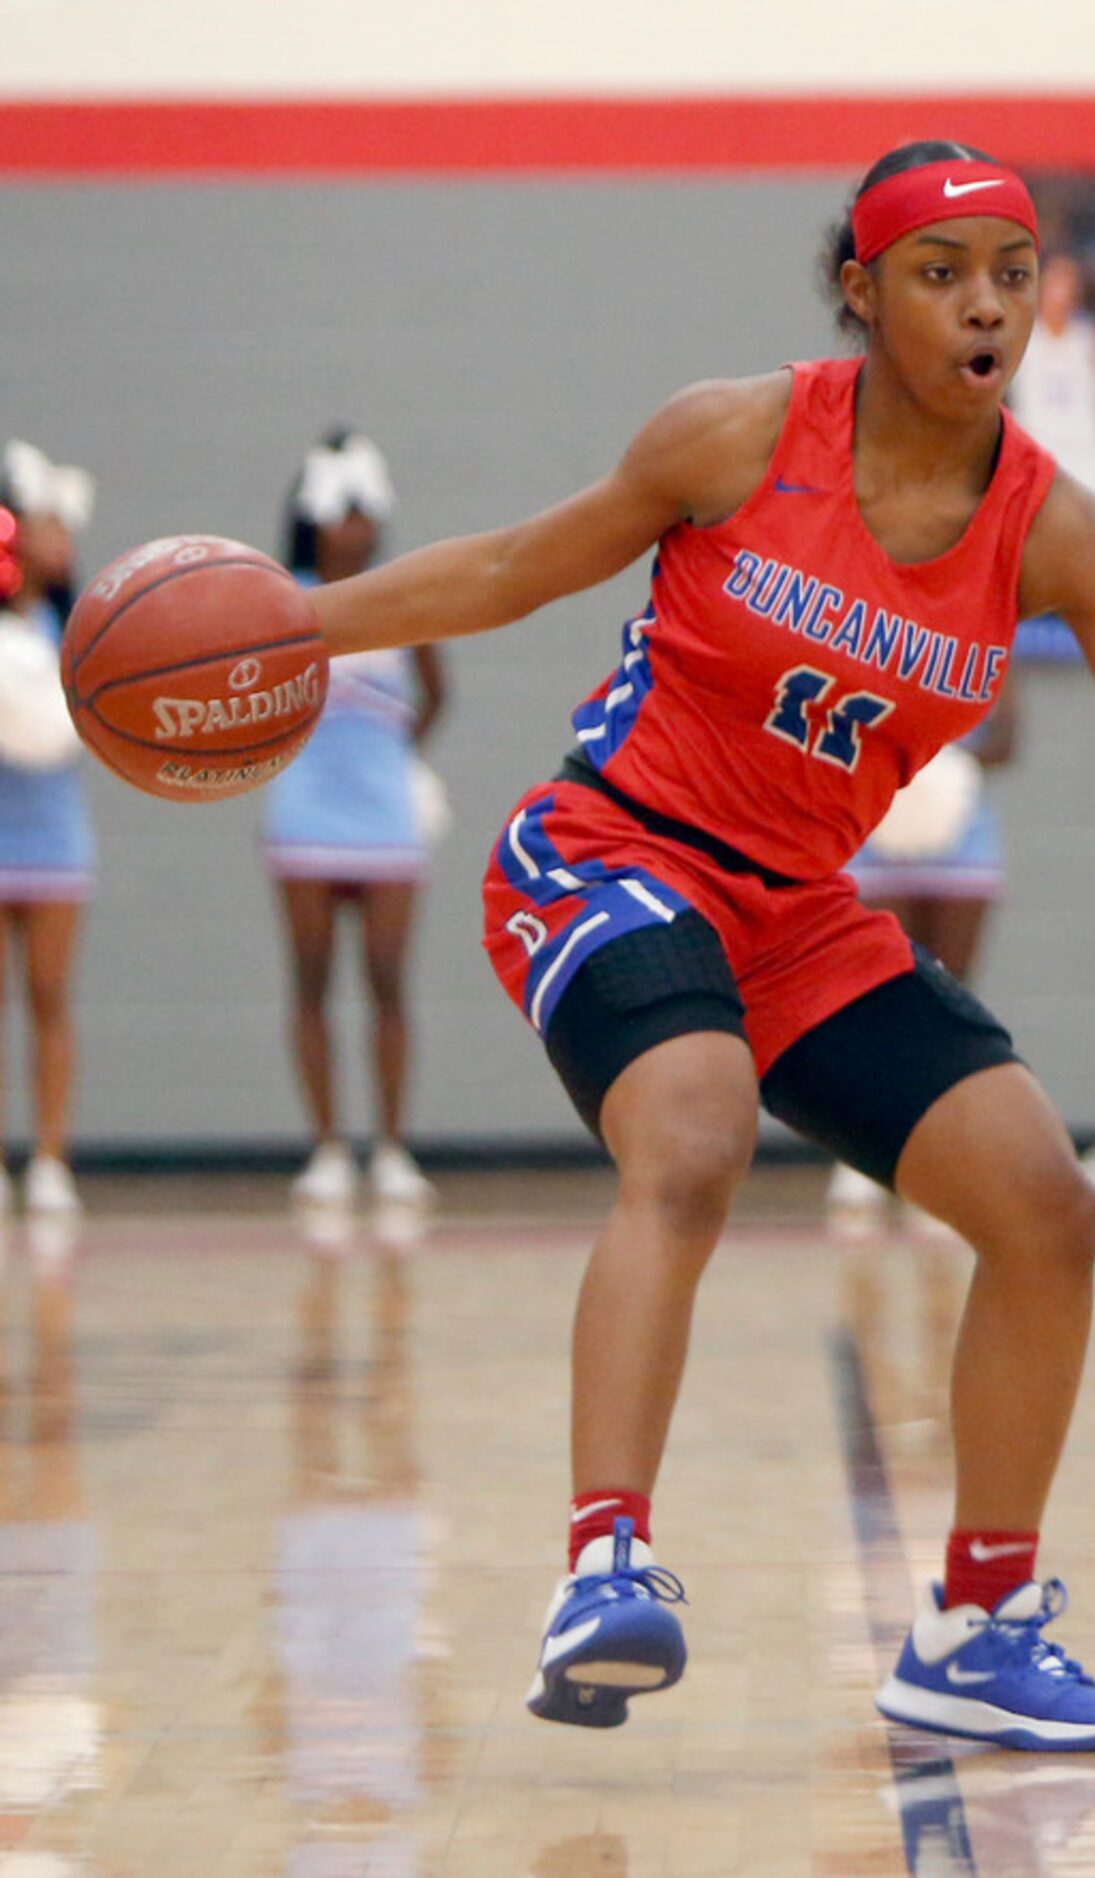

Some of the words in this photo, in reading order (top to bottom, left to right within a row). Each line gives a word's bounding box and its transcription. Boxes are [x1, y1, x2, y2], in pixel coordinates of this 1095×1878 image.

[723, 549, 1006, 704] DUNCANVILLE
[153, 662, 319, 741] SPALDING
[762, 664, 897, 774] 11
[506, 911, 548, 957] D
